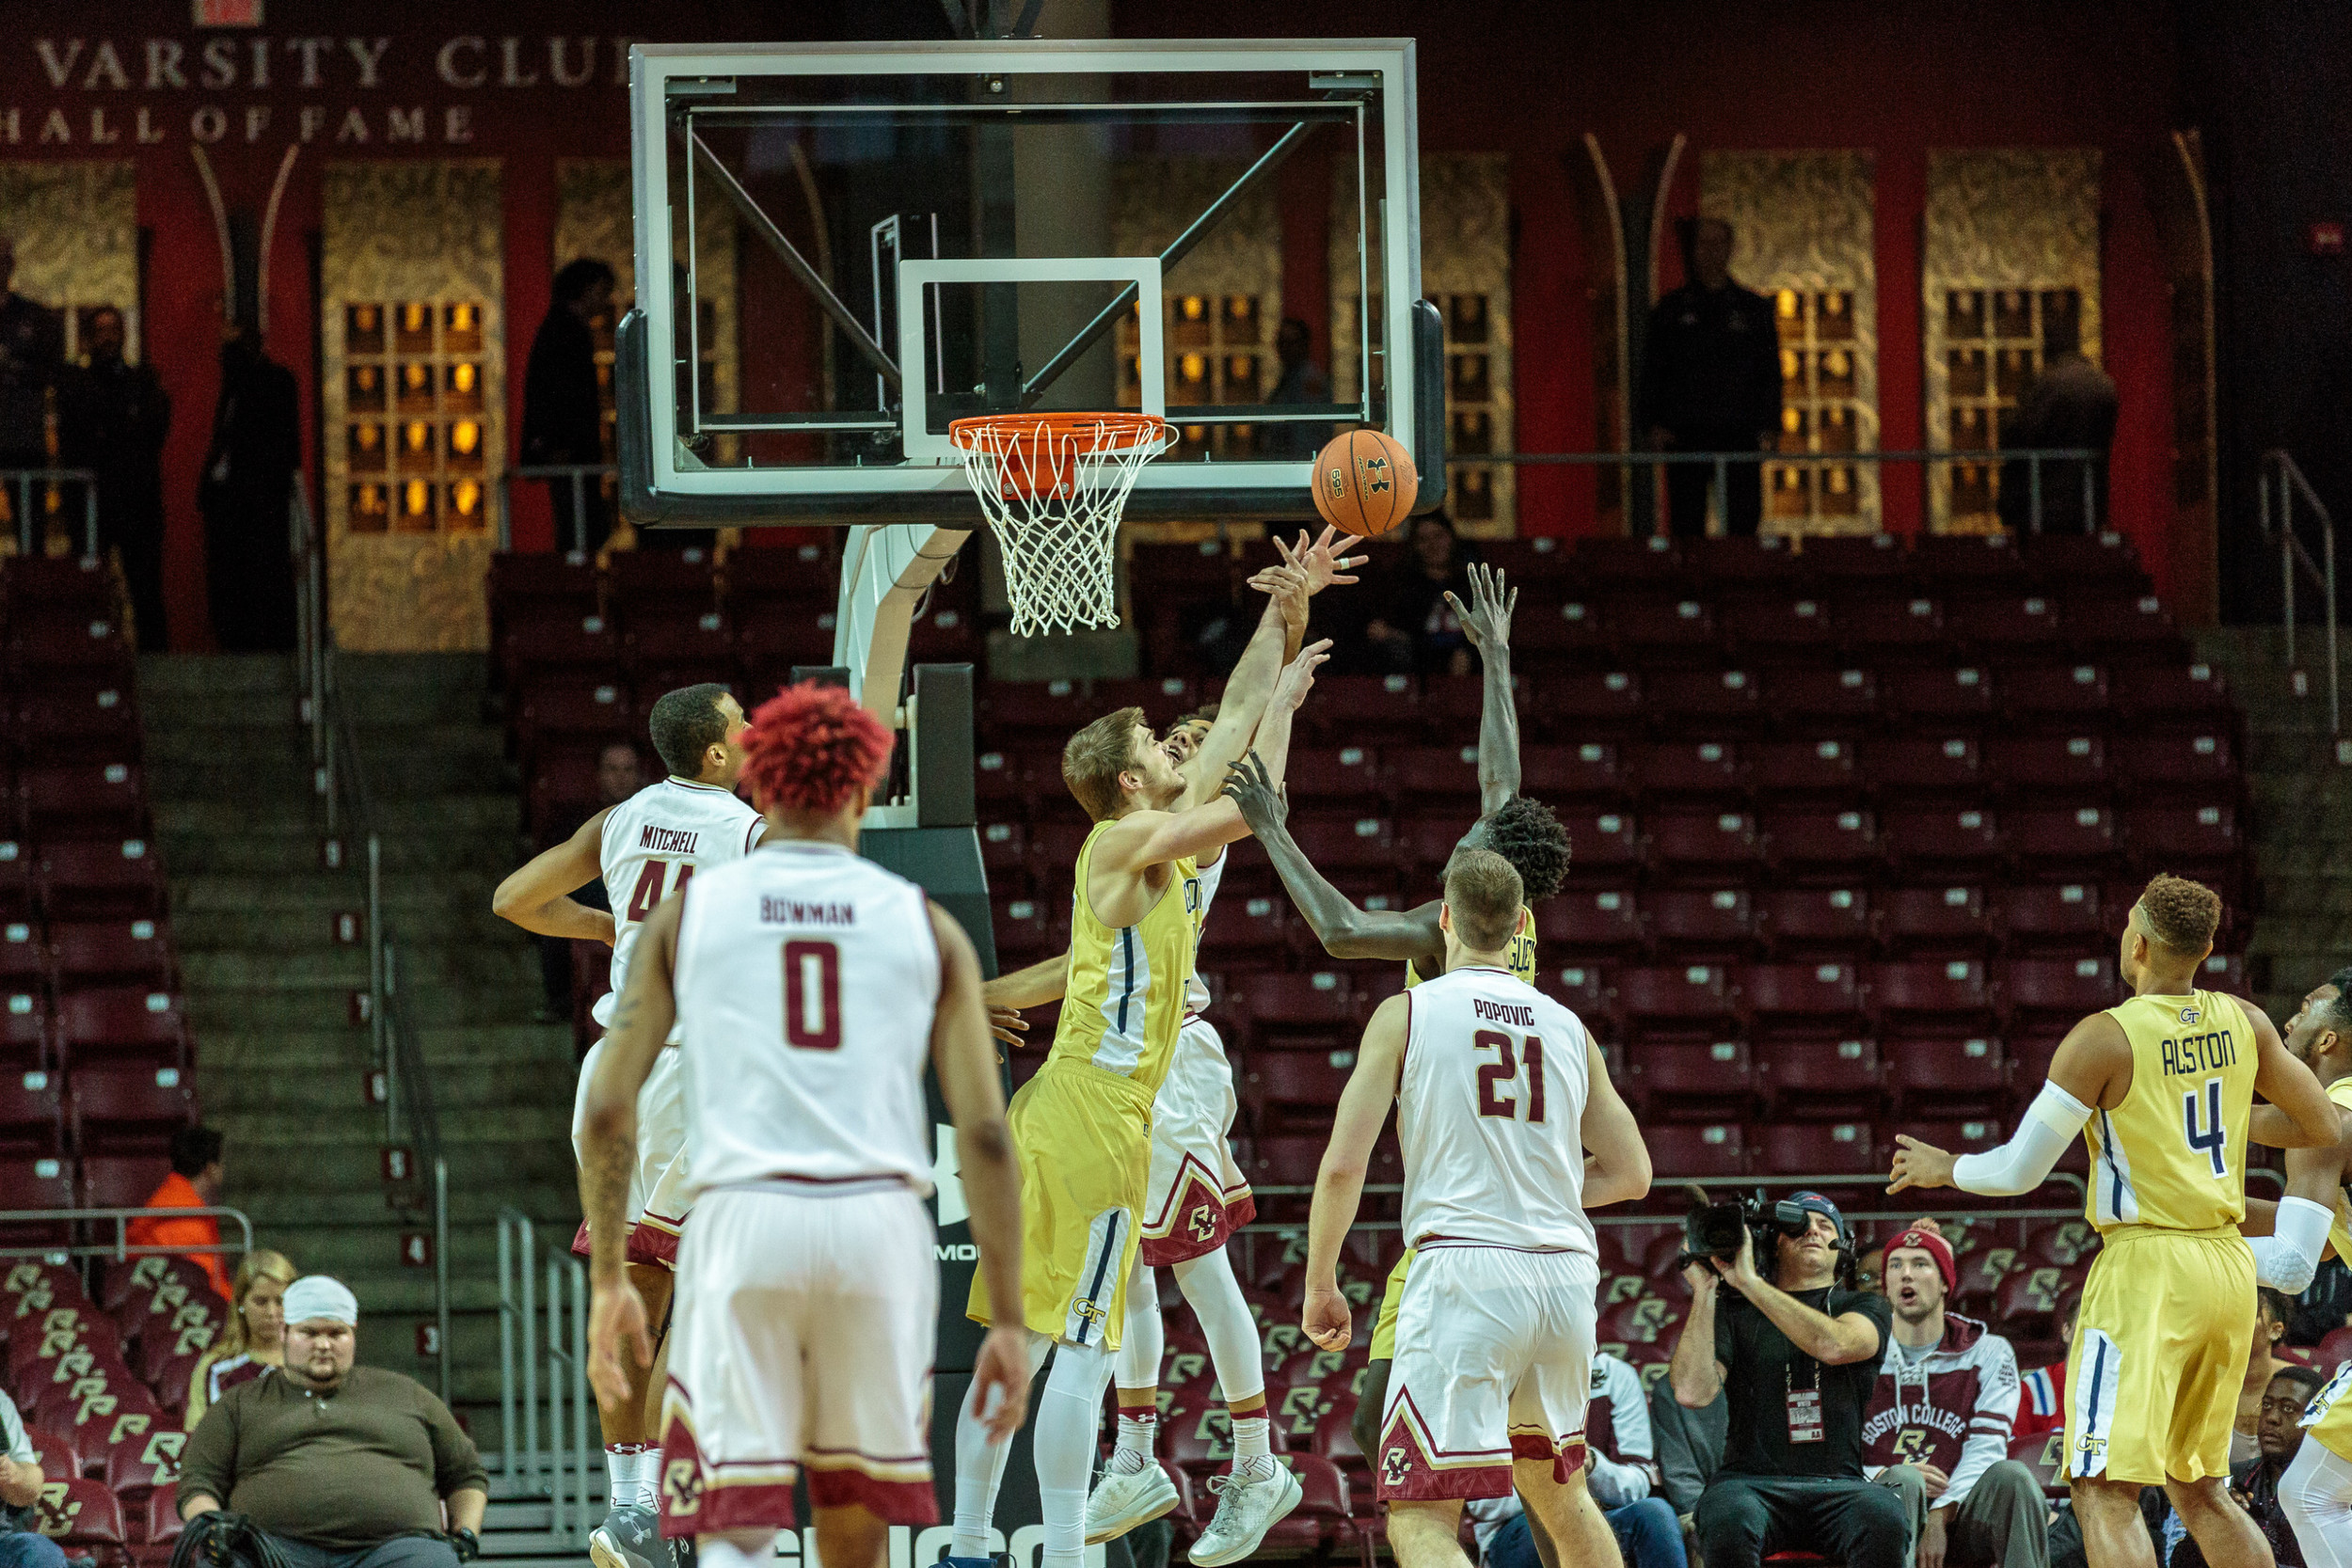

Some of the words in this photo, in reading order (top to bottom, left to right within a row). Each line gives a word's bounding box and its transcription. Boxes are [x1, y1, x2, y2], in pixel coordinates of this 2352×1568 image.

[36, 37, 391, 89] VARSITY
[192, 105, 273, 144] OF
[298, 104, 472, 144] FAME
[1331, 468, 1345, 499] 695
[639, 825, 699, 854] MITCHELL
[626, 858, 696, 925] 4
[759, 895, 857, 926] BOWMAN
[784, 940, 842, 1051] 0
[1473, 998, 1535, 1027] POPOVIC
[2162, 1030, 2236, 1076] ALSTON
[1472, 1029, 1546, 1125] 21
[2184, 1076, 2230, 1180] 4
[1073, 1297, 1106, 1324] GT
[1861, 1403, 1910, 1447] BOSTON
[1911, 1403, 1967, 1440] COLLEGE
